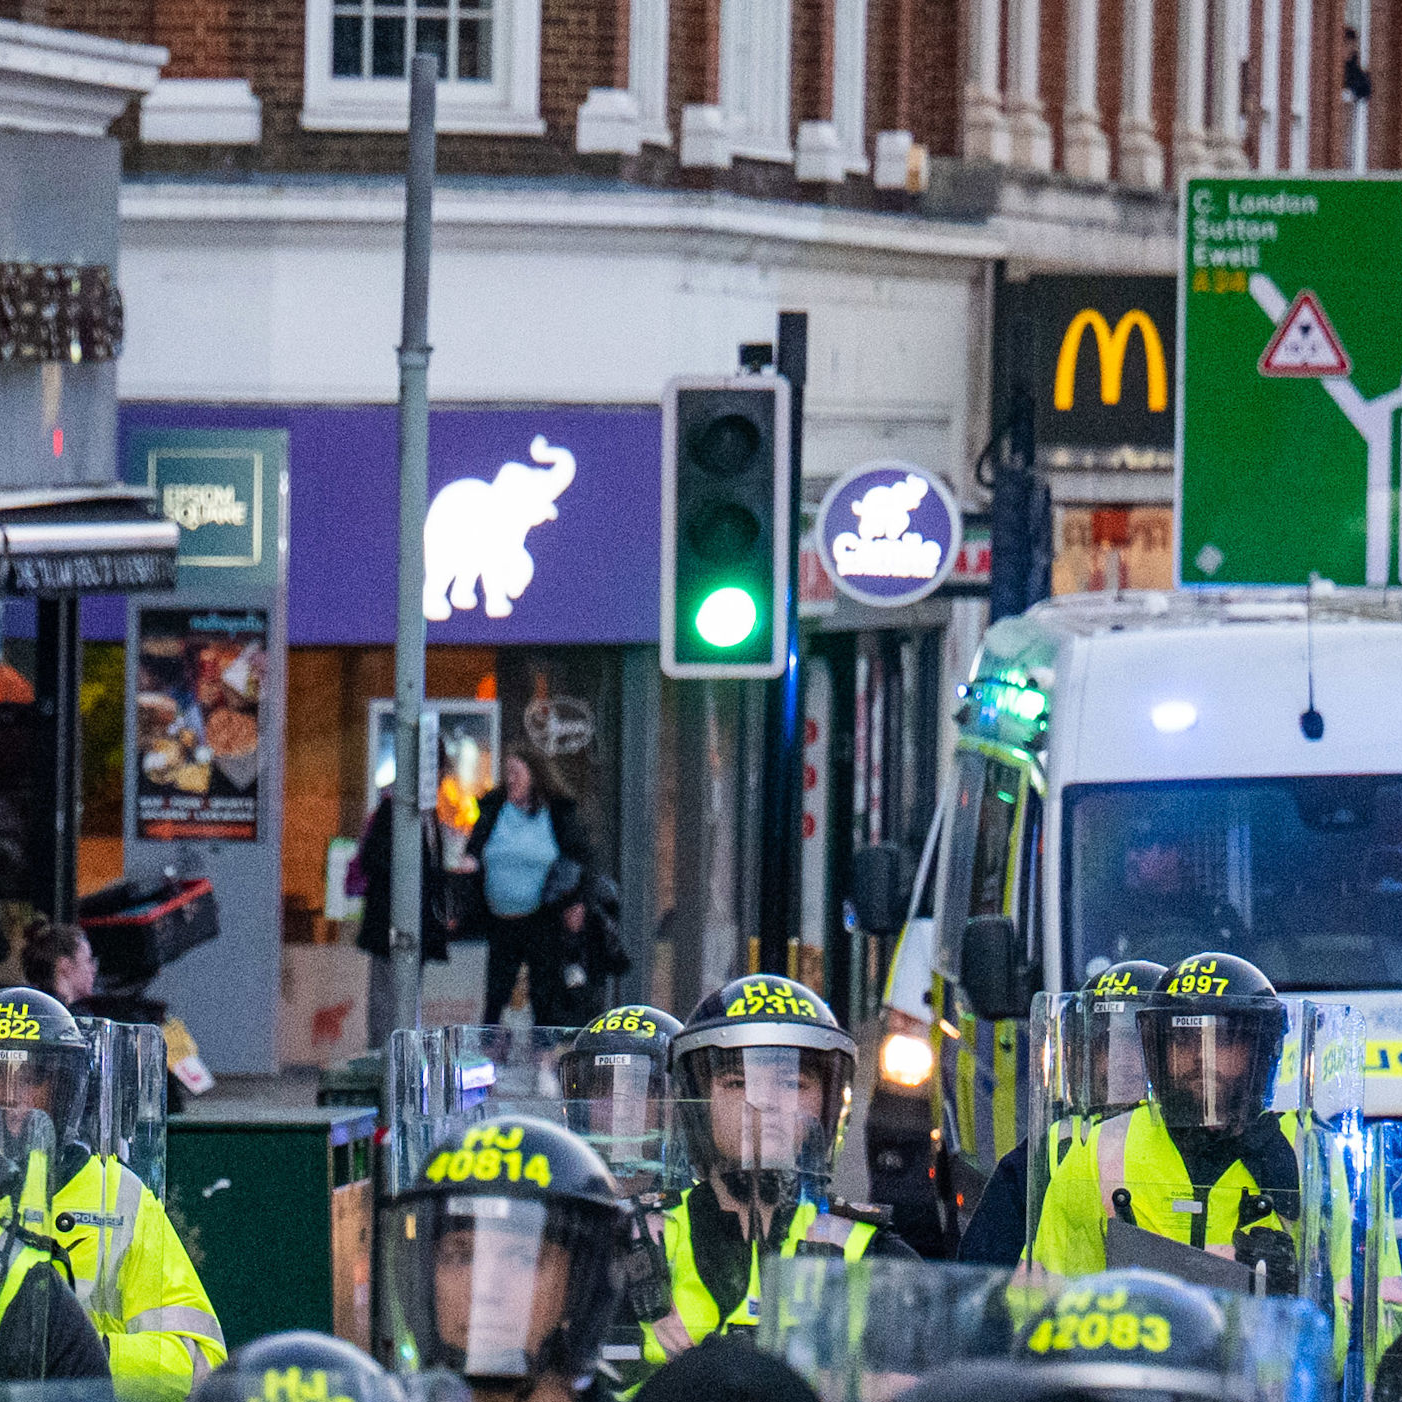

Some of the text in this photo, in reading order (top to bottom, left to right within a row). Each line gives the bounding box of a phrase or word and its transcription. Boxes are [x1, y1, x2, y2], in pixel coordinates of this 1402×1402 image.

[1228, 190, 1319, 214] London
[1192, 216, 1278, 241] Sutton
[1192, 242, 1260, 268] Ewell
[1097, 972, 1131, 988] HJ
[1178, 961, 1217, 976] HJ
[743, 981, 793, 1000] HJ
[1166, 975, 1229, 997] 4997
[726, 995, 817, 1018] 42313
[590, 1015, 656, 1038] 4663
[1176, 1016, 1203, 1026] POLICE
[598, 1055, 628, 1066] POLICE
[426, 1148, 552, 1188] 40814
[1028, 1313, 1171, 1353] 42083
